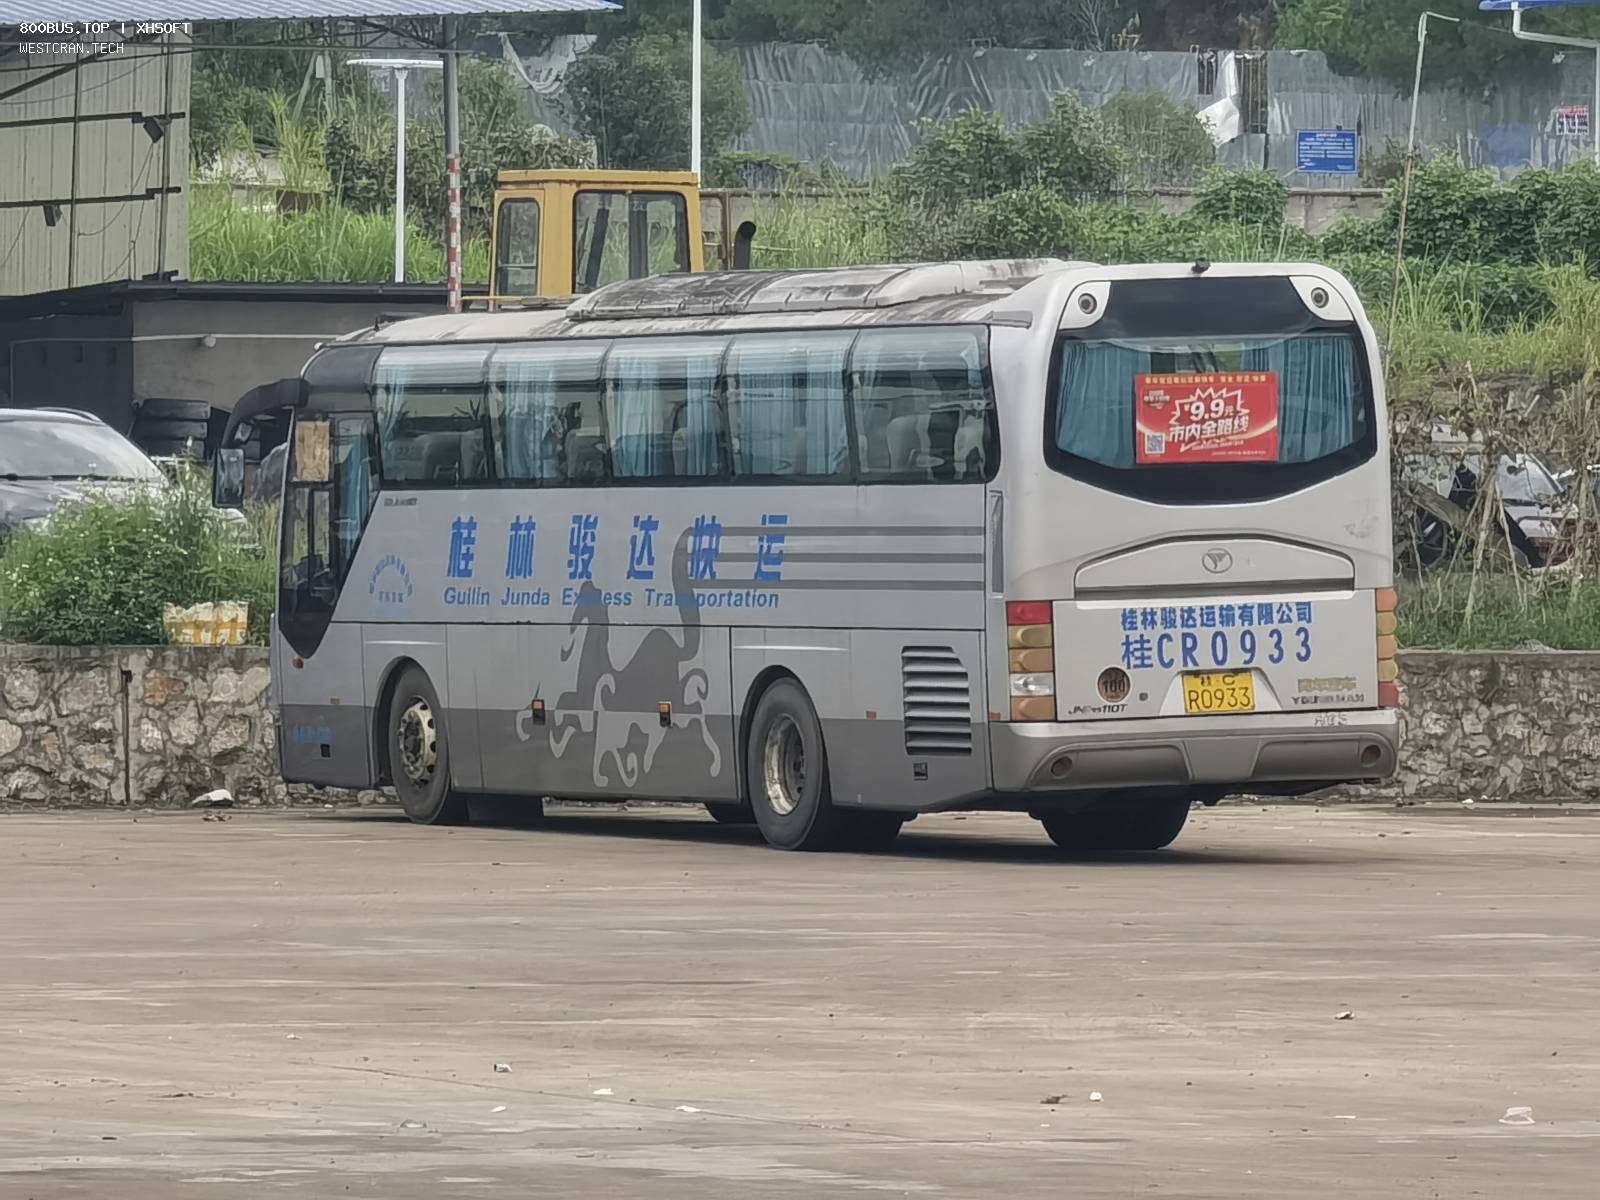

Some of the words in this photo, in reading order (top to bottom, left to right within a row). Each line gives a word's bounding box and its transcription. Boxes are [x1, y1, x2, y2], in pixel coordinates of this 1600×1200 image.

[1169, 415, 1249, 443] 市内全路线
[446, 514, 789, 581] 桂林骏达快运
[444, 587, 490, 607] Guilin
[501, 588, 550, 607] Junda
[1120, 601, 1313, 631] 桂林骏达运输有限公司
[1121, 626, 1313, 669] 桂CR0933
[1102, 679, 1126, 694] 100
[1187, 687, 1251, 710] R0933
